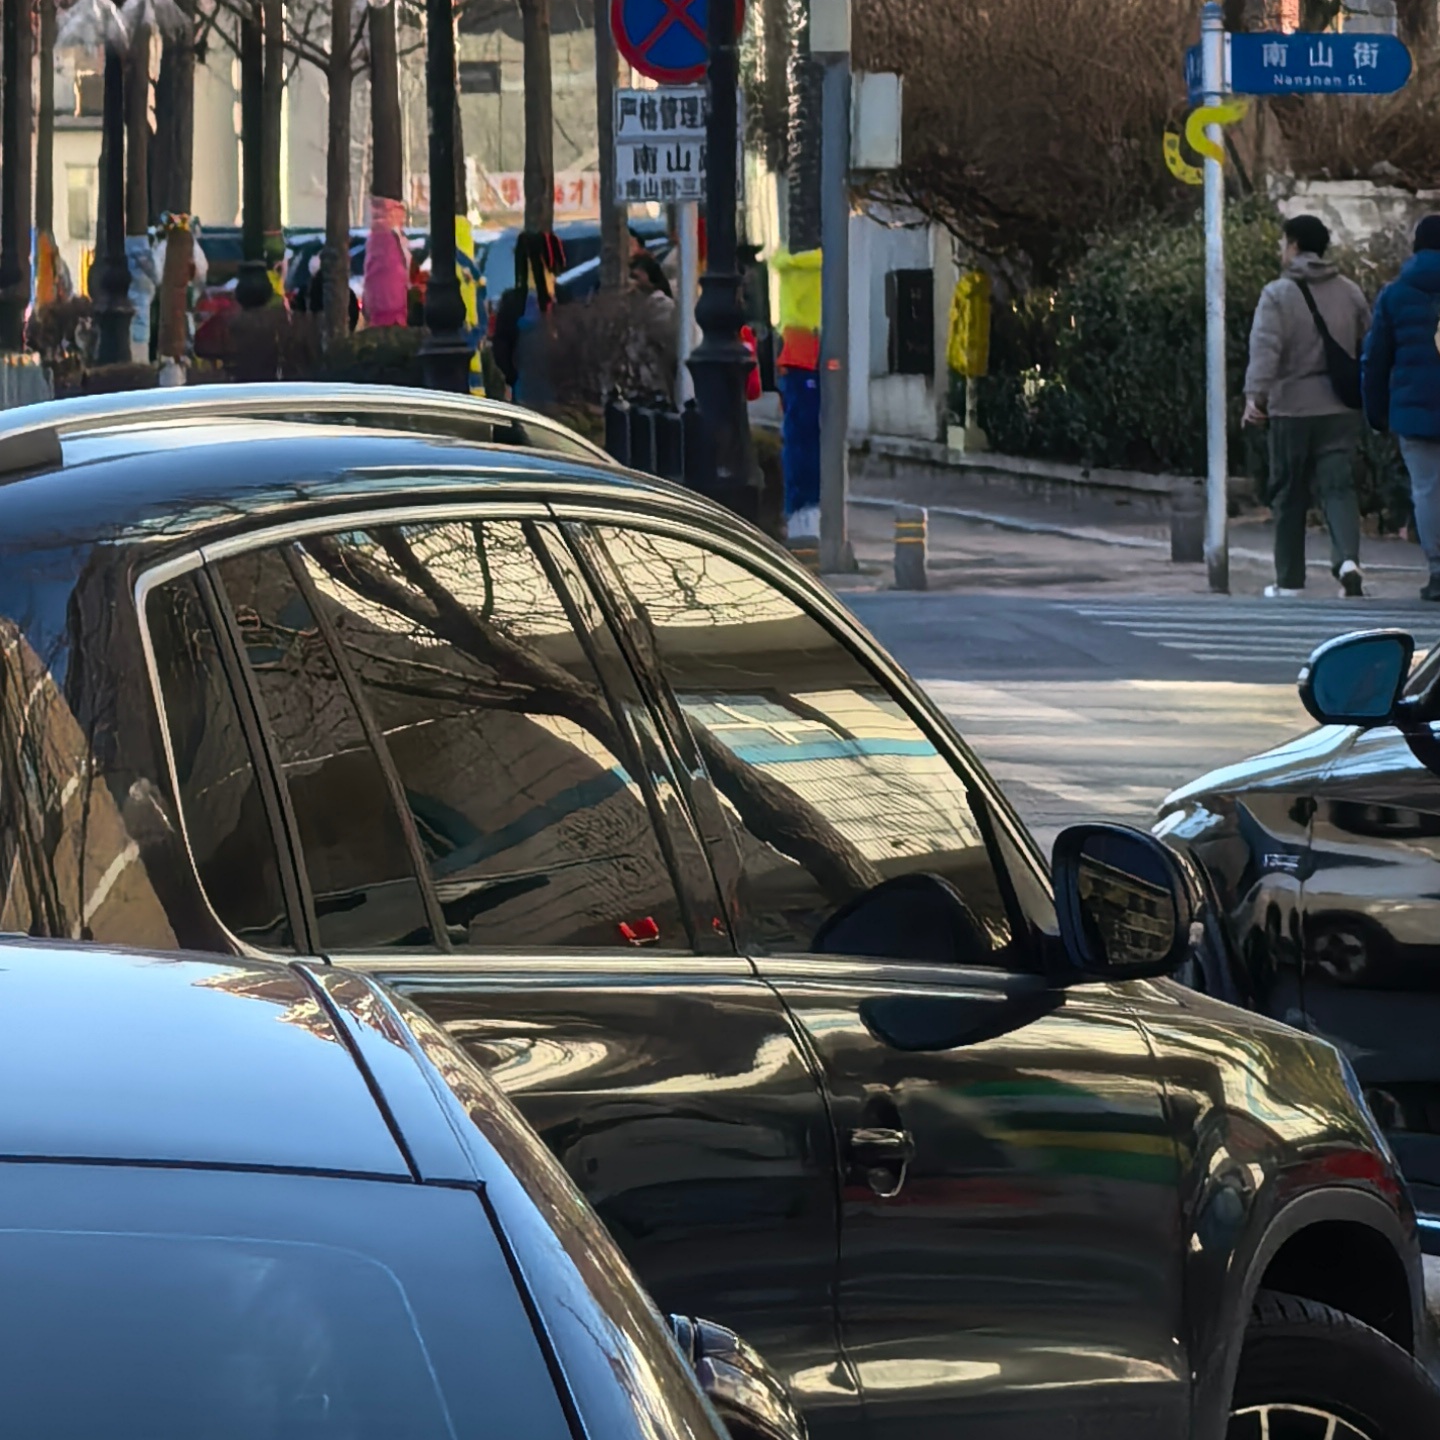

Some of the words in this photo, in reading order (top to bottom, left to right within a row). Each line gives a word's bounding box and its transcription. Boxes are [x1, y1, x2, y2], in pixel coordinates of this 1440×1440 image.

[1261, 39, 1380, 69] 南山街
[1273, 73, 1342, 87] Nanshan
[1347, 73, 1367, 87] St.
[619, 95, 707, 132] 严格管理
[633, 142, 707, 175] 南山
